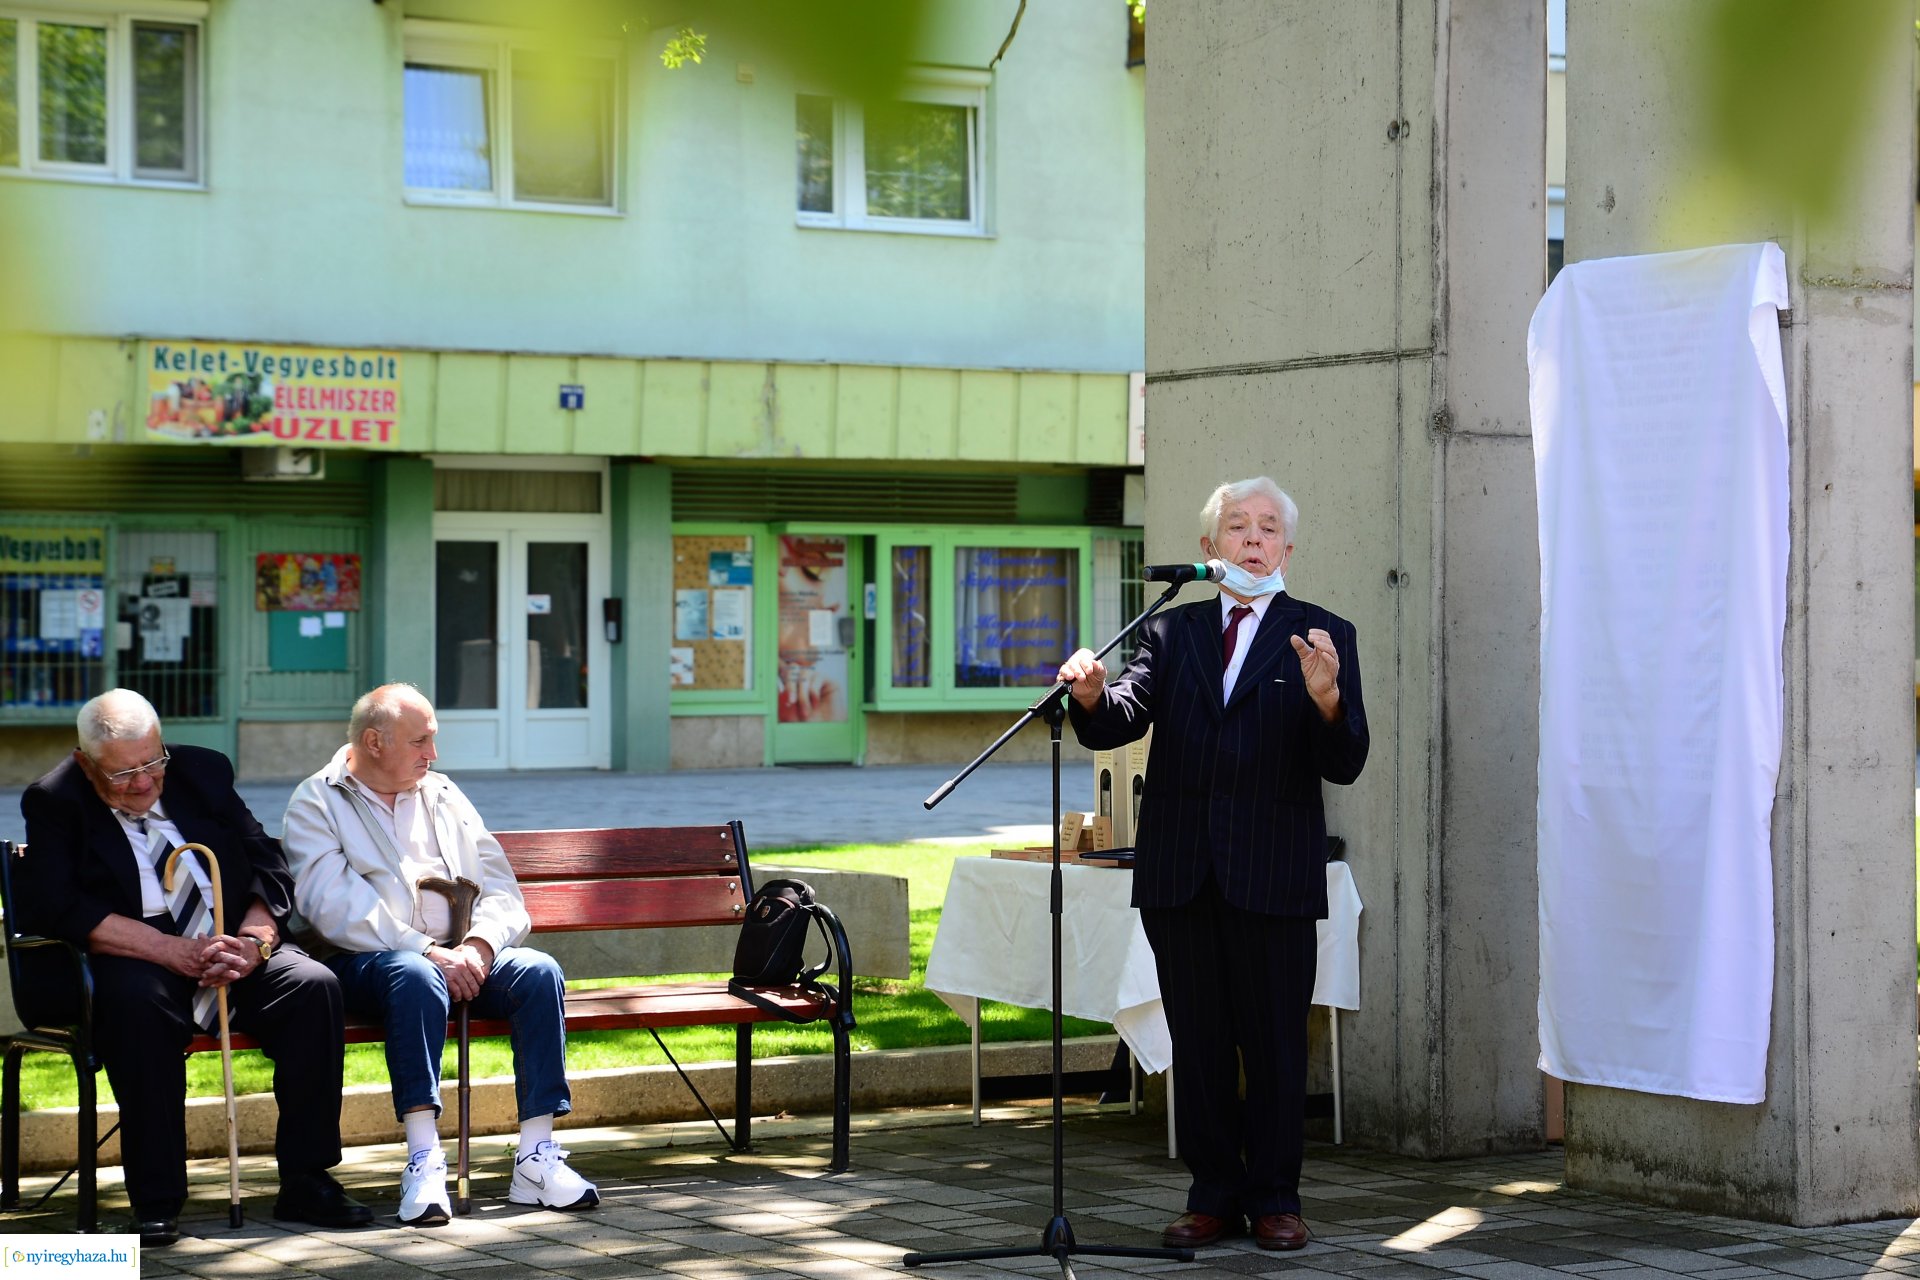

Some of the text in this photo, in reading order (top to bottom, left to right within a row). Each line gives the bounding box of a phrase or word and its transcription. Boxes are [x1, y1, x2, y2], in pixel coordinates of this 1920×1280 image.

[154, 346, 397, 380] Kelet-Vegyesbolt
[273, 381, 396, 412] ÉLELMISZER
[273, 412, 395, 442] ÜZLET
